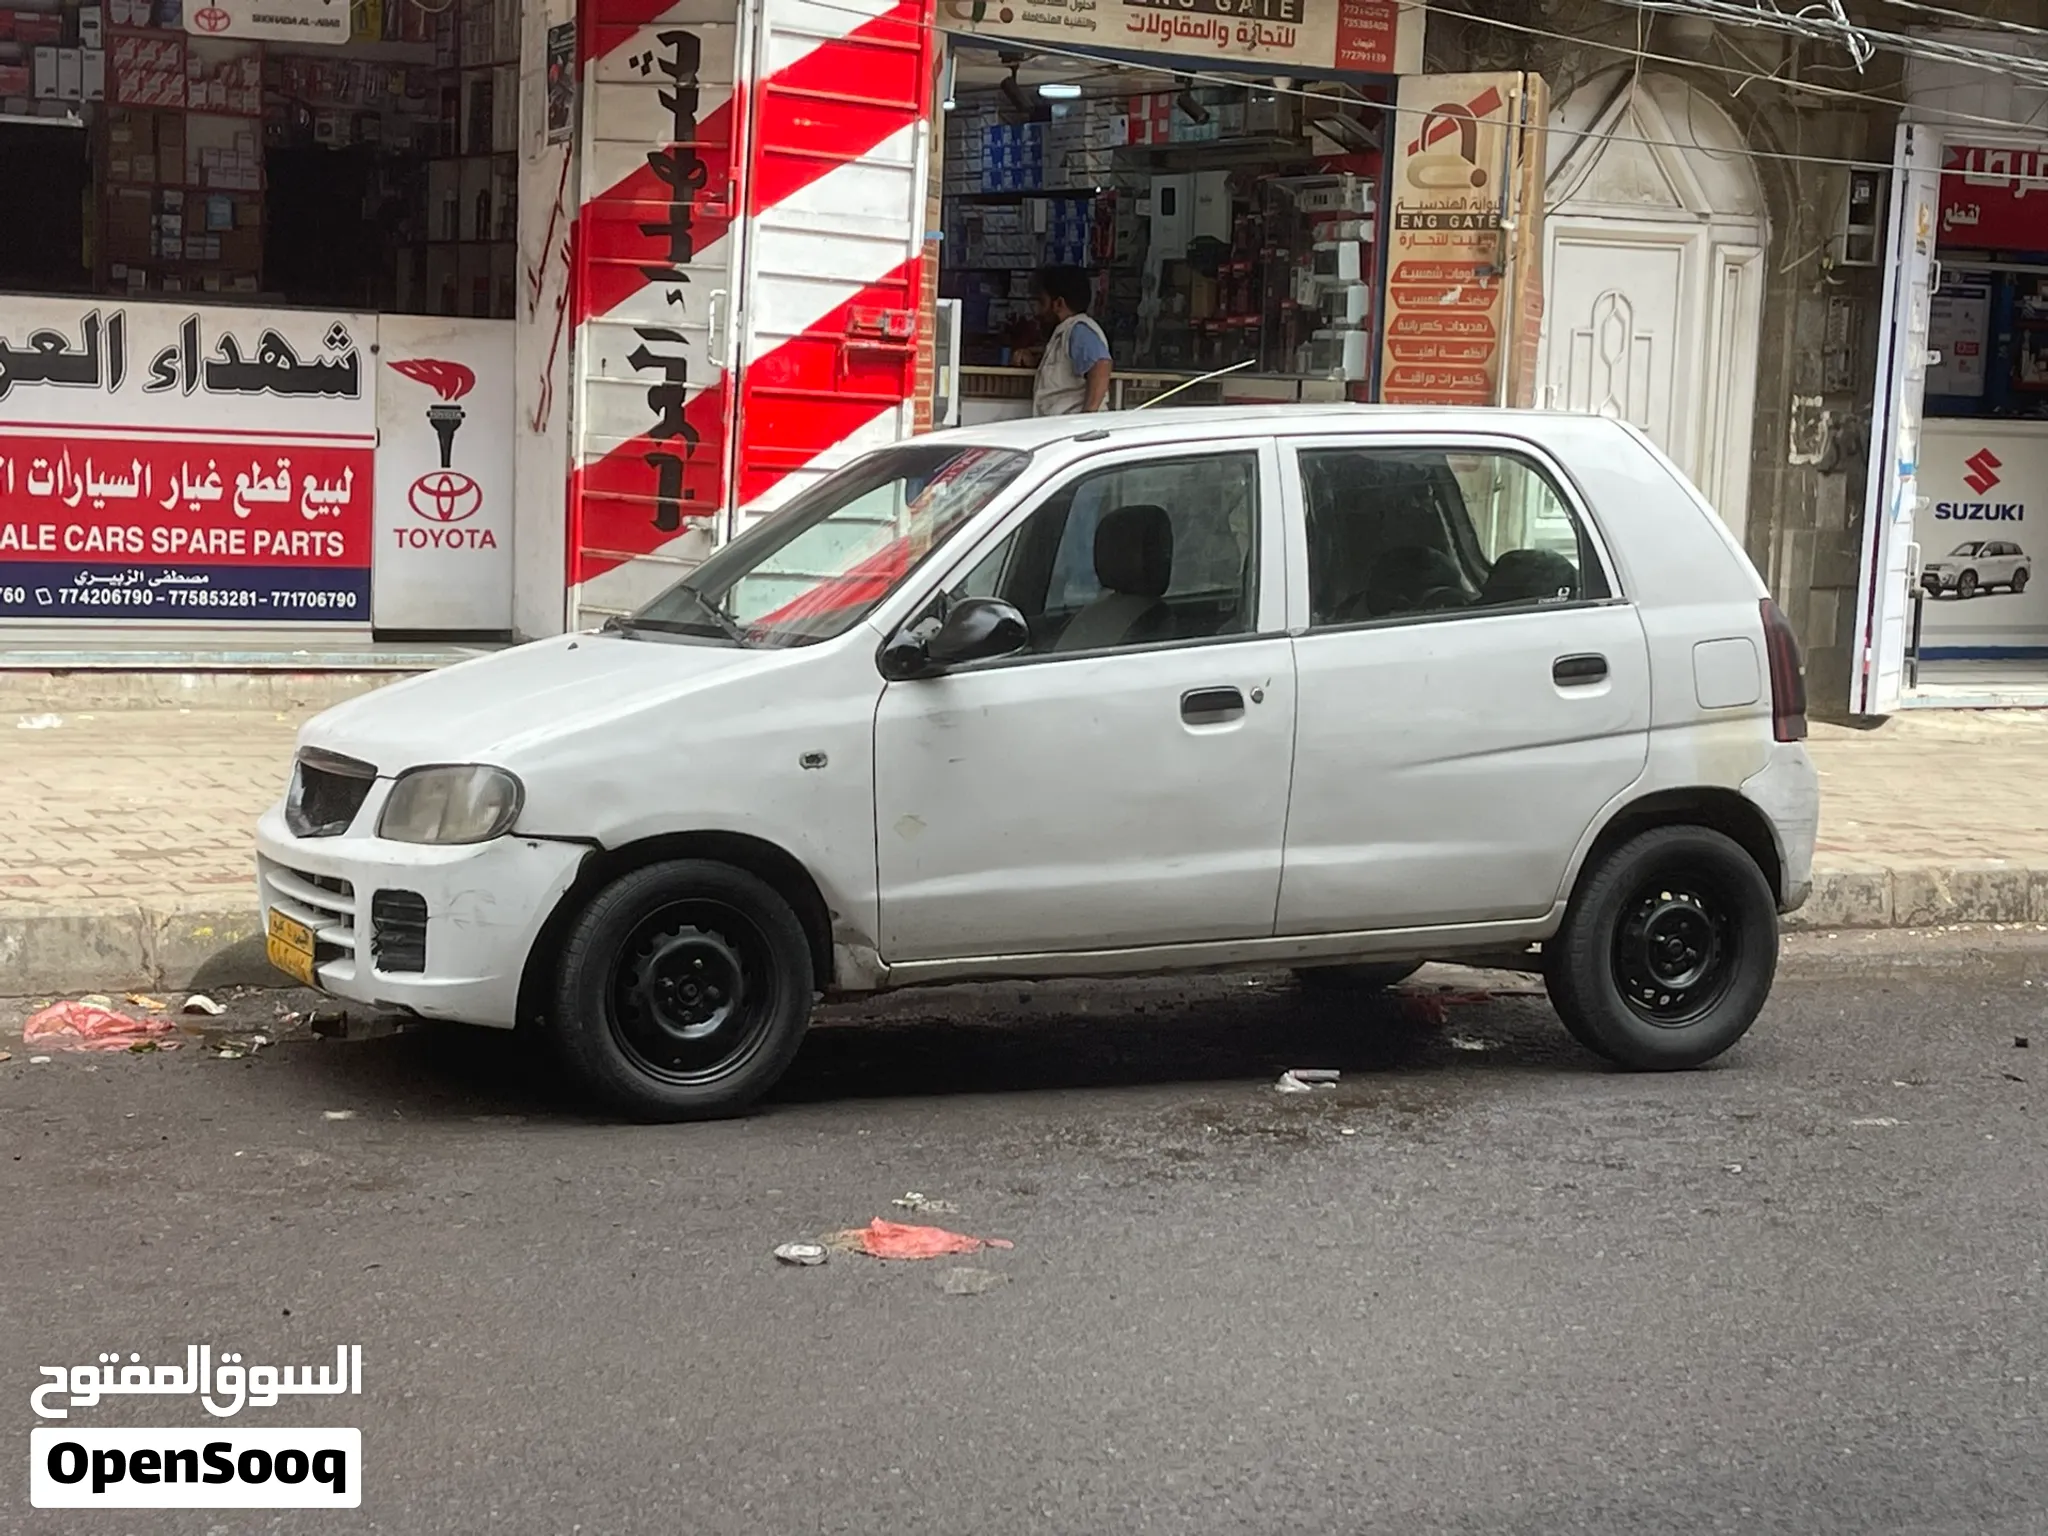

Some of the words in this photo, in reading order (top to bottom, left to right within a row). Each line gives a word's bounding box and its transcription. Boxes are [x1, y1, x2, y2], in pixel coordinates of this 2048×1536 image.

[1126, 13, 1230, 48] والمقاولات
[628, 30, 709, 314] شهداء
[1400, 215, 1438, 228] ENG
[1449, 215, 1497, 228] GATE
[143, 313, 361, 400] شهداء
[626, 327, 701, 533] العرب
[27, 443, 152, 509] السيارات
[159, 459, 224, 512] غيار
[233, 458, 292, 518] قطع
[301, 465, 354, 520] لبيع
[1935, 502, 2024, 521] SUZUKI
[64, 524, 144, 553] CARS
[151, 526, 246, 555] SPARE
[253, 529, 344, 557] PARTS
[393, 528, 497, 549] TOYOTA
[74, 569, 144, 586] الزبيري
[148, 569, 209, 587] مصطفى
